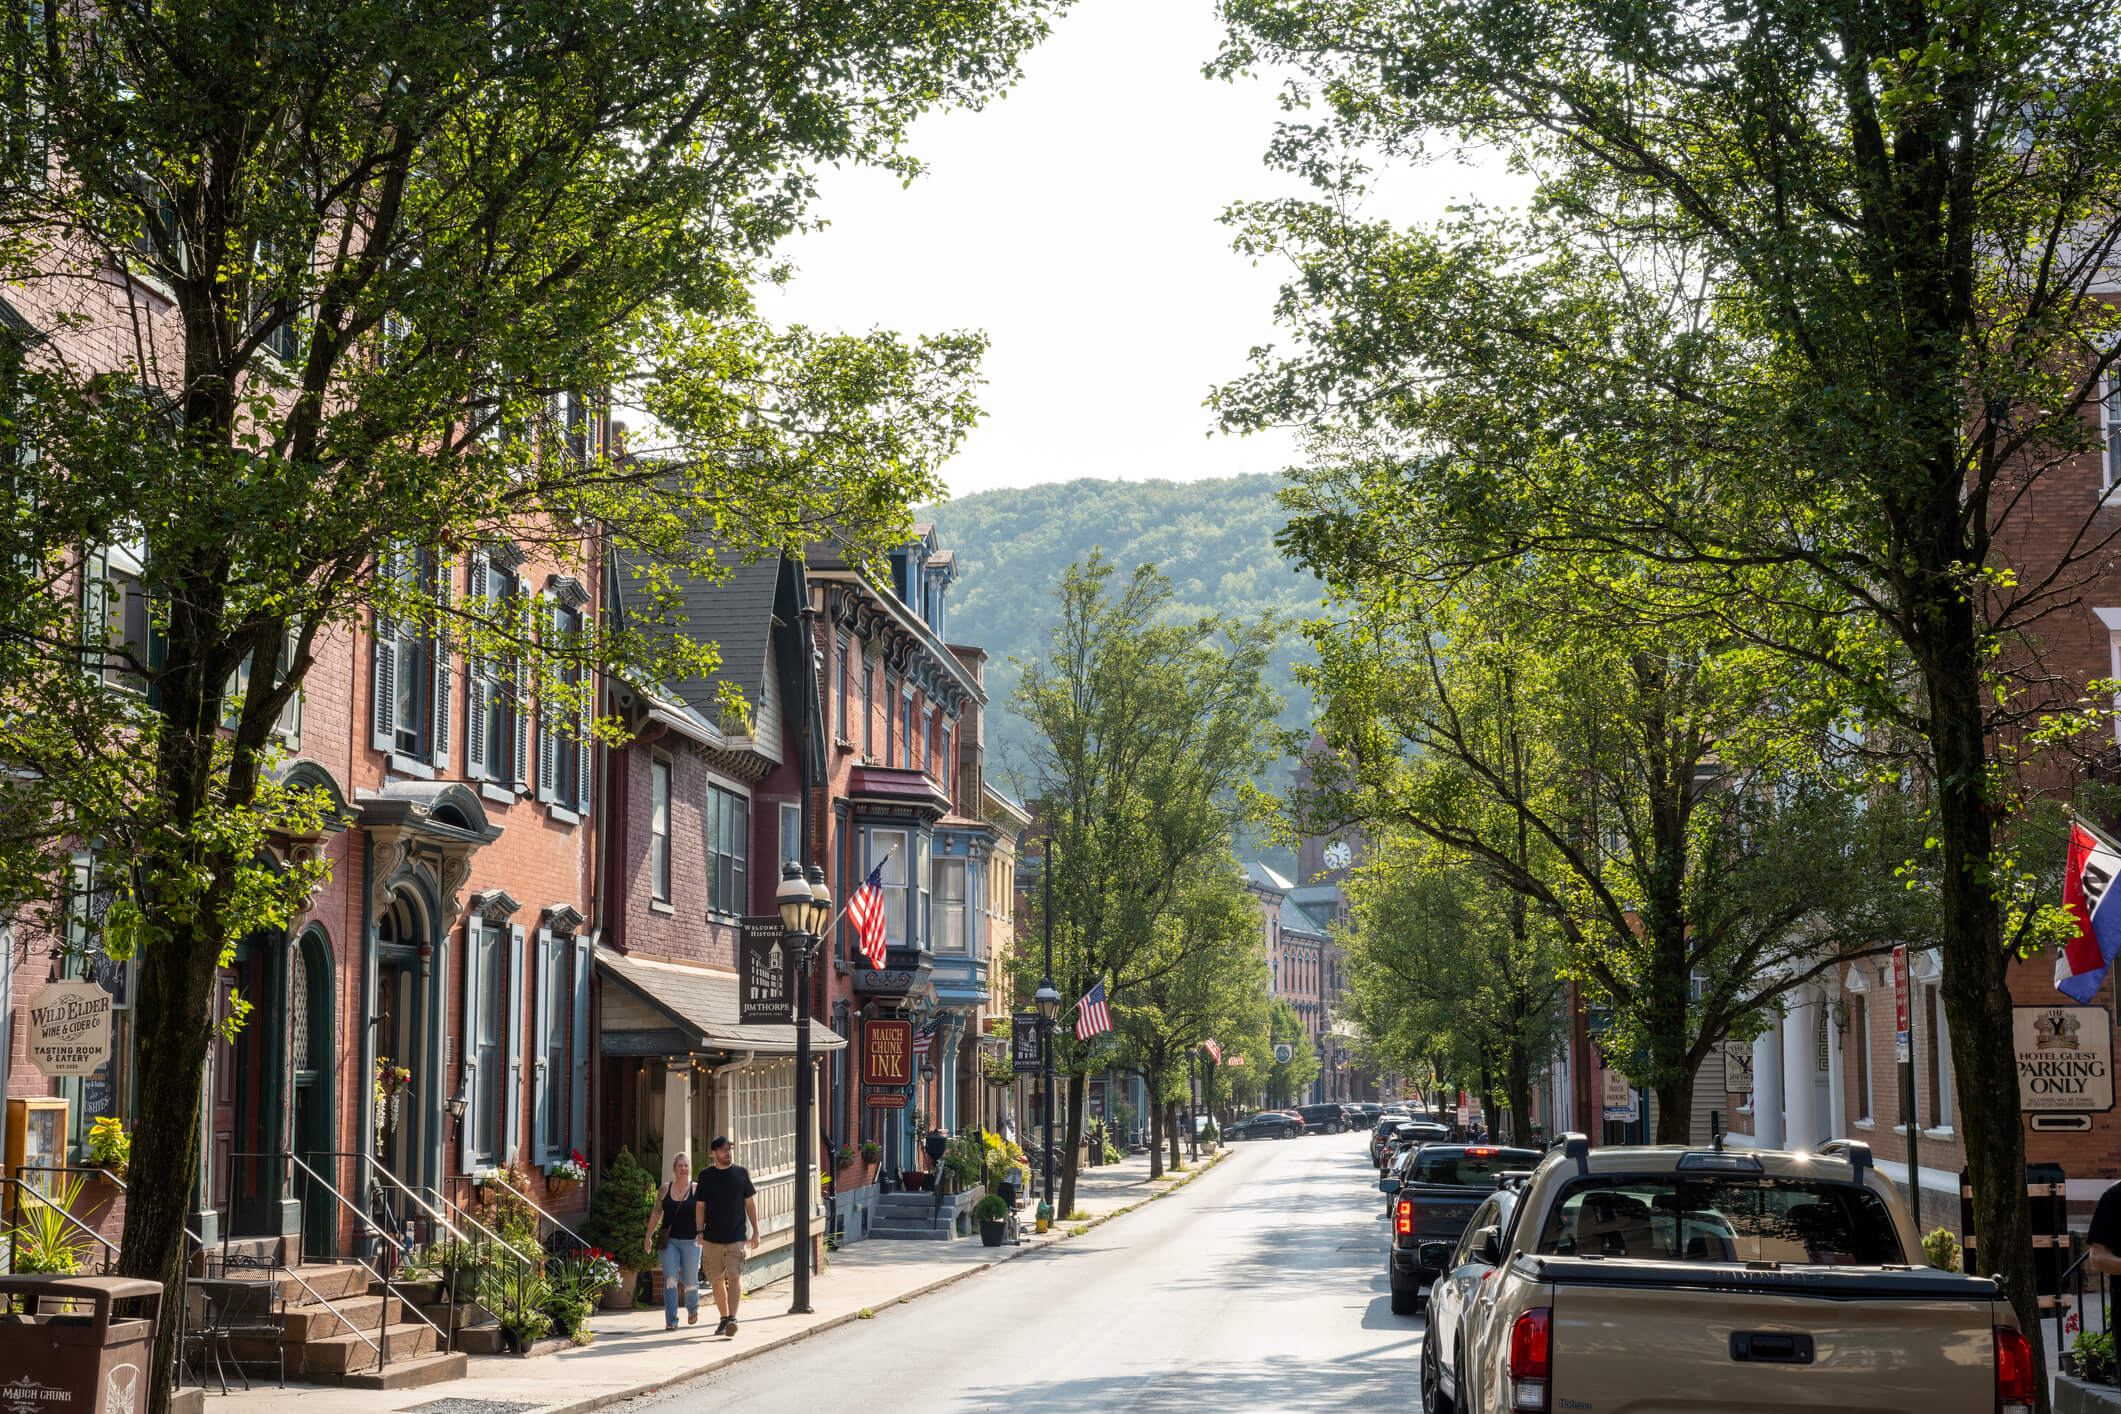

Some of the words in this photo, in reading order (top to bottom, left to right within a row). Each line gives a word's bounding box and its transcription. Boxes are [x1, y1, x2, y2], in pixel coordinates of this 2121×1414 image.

[30, 1006, 66, 1028] WILD
[68, 997, 110, 1020] ELDER
[757, 1003, 791, 1011] THORPE
[42, 1025, 61, 1039] WINE
[62, 1024, 69, 1035] &
[69, 1020, 91, 1033] CIDER
[872, 1028, 903, 1040] MAUCH
[2048, 1017, 2065, 1036] Y
[872, 1041, 903, 1054] CHUNK
[56, 1054, 90, 1062] EATERY
[2020, 1052, 2057, 1061] HOTEL
[2060, 1052, 2097, 1060] GUEST
[872, 1055, 903, 1077] INK
[2030, 1077, 2088, 1094] ONLY
